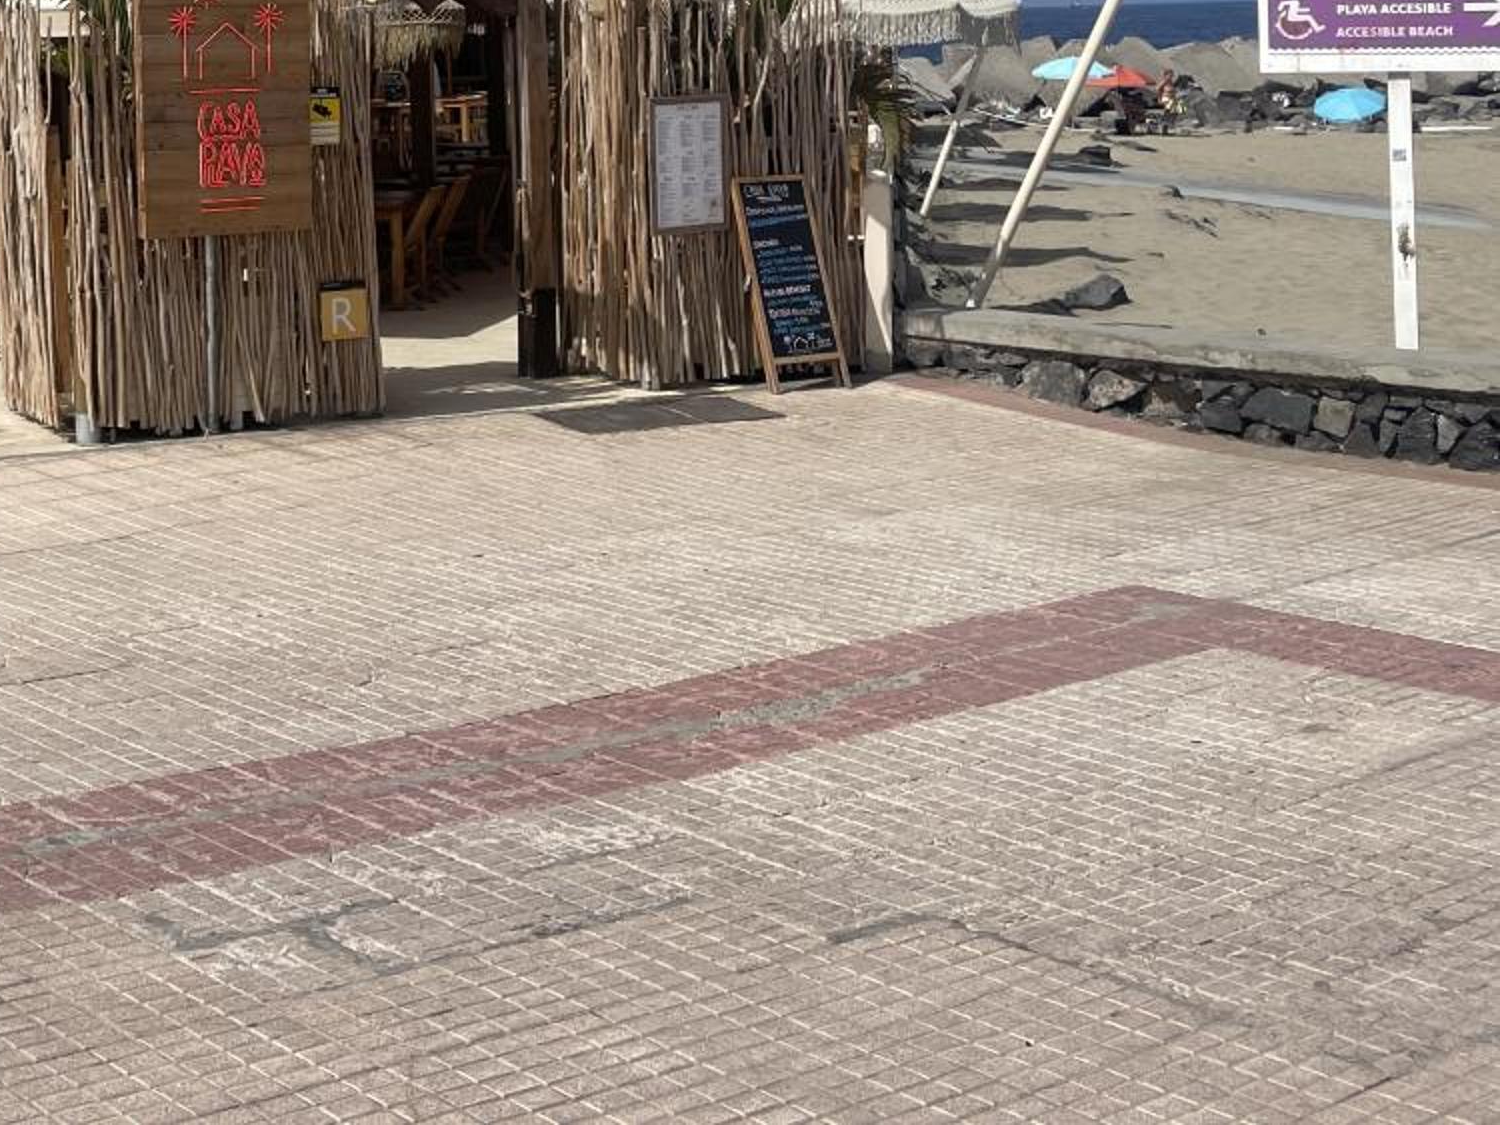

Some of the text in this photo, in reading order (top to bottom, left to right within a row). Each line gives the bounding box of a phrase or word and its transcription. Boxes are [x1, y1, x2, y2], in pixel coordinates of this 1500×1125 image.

[1336, 2, 1453, 16] PLAYA ACCESIBLE
[1335, 26, 1454, 38] ACCESIBLE BEACH
[197, 98, 261, 139] CASA
[331, 296, 357, 334] R
